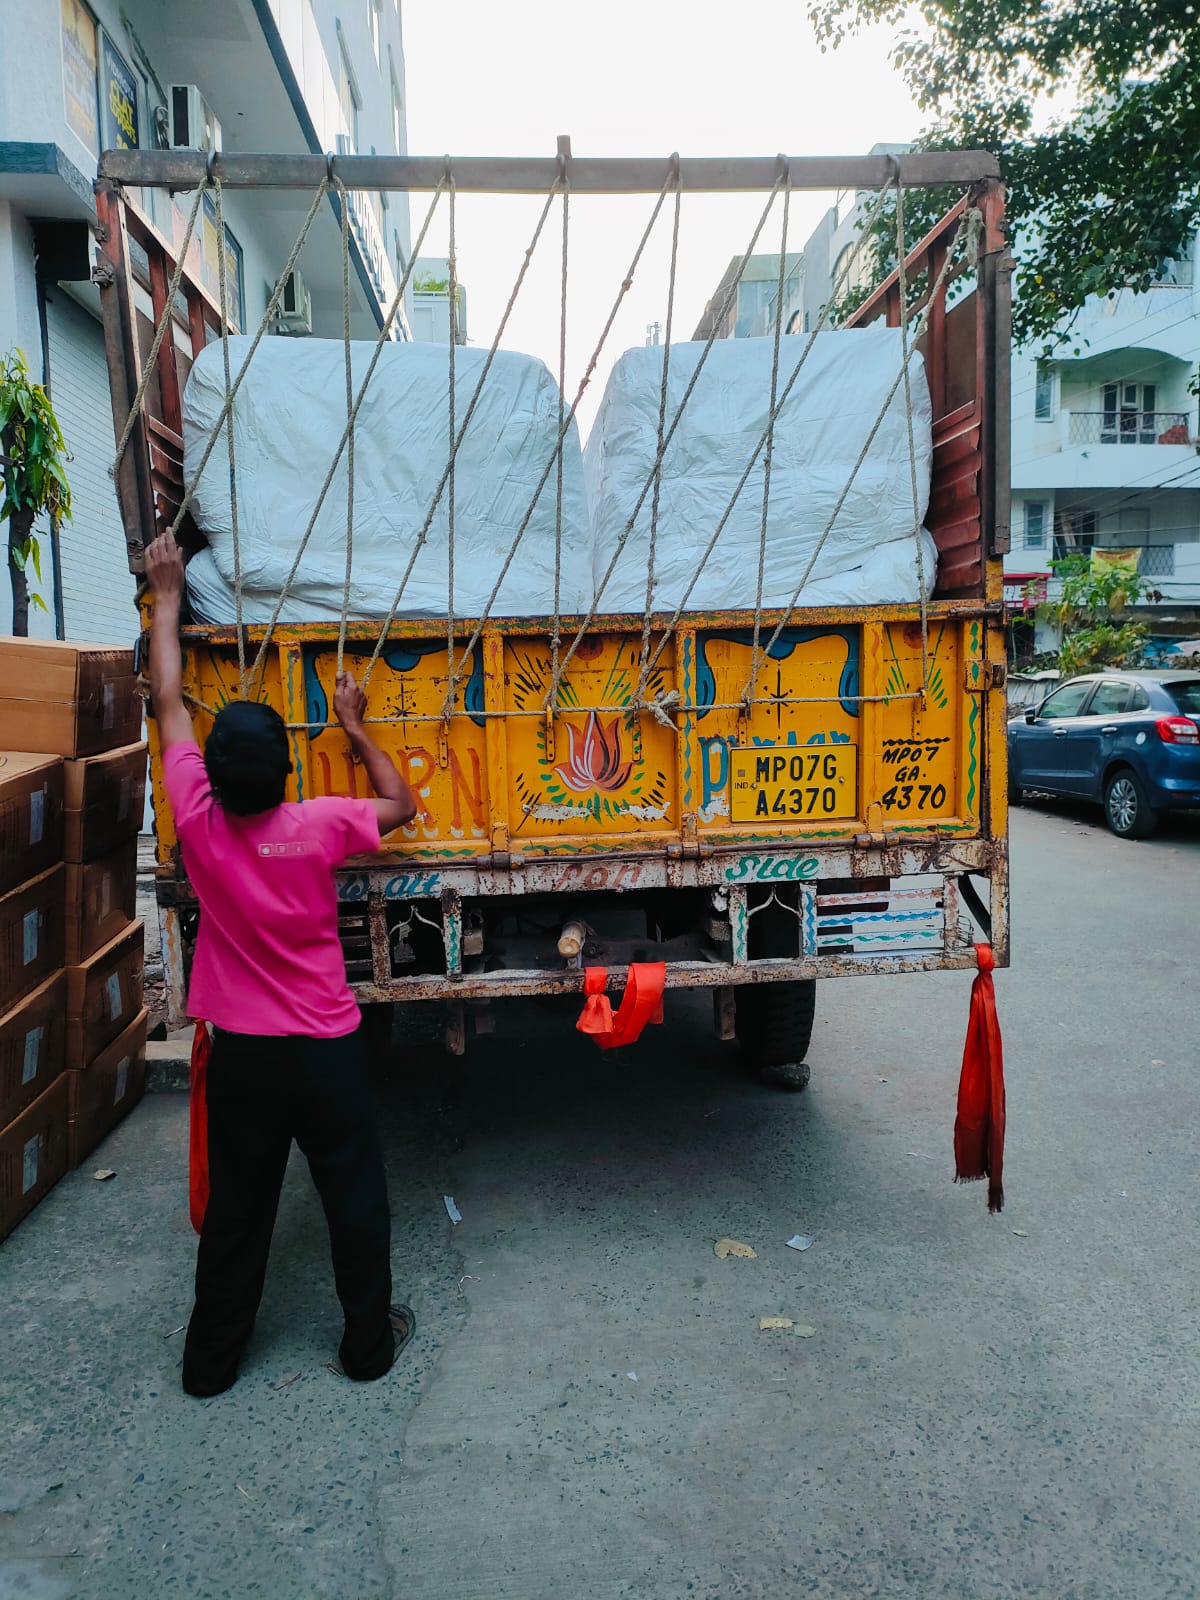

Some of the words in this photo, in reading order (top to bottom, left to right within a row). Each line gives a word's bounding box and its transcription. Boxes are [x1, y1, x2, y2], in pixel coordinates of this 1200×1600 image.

[755, 754, 837, 783] MP07G
[882, 746, 939, 764] MP07
[755, 787, 836, 816] A4370
[882, 784, 947, 811] 4370
